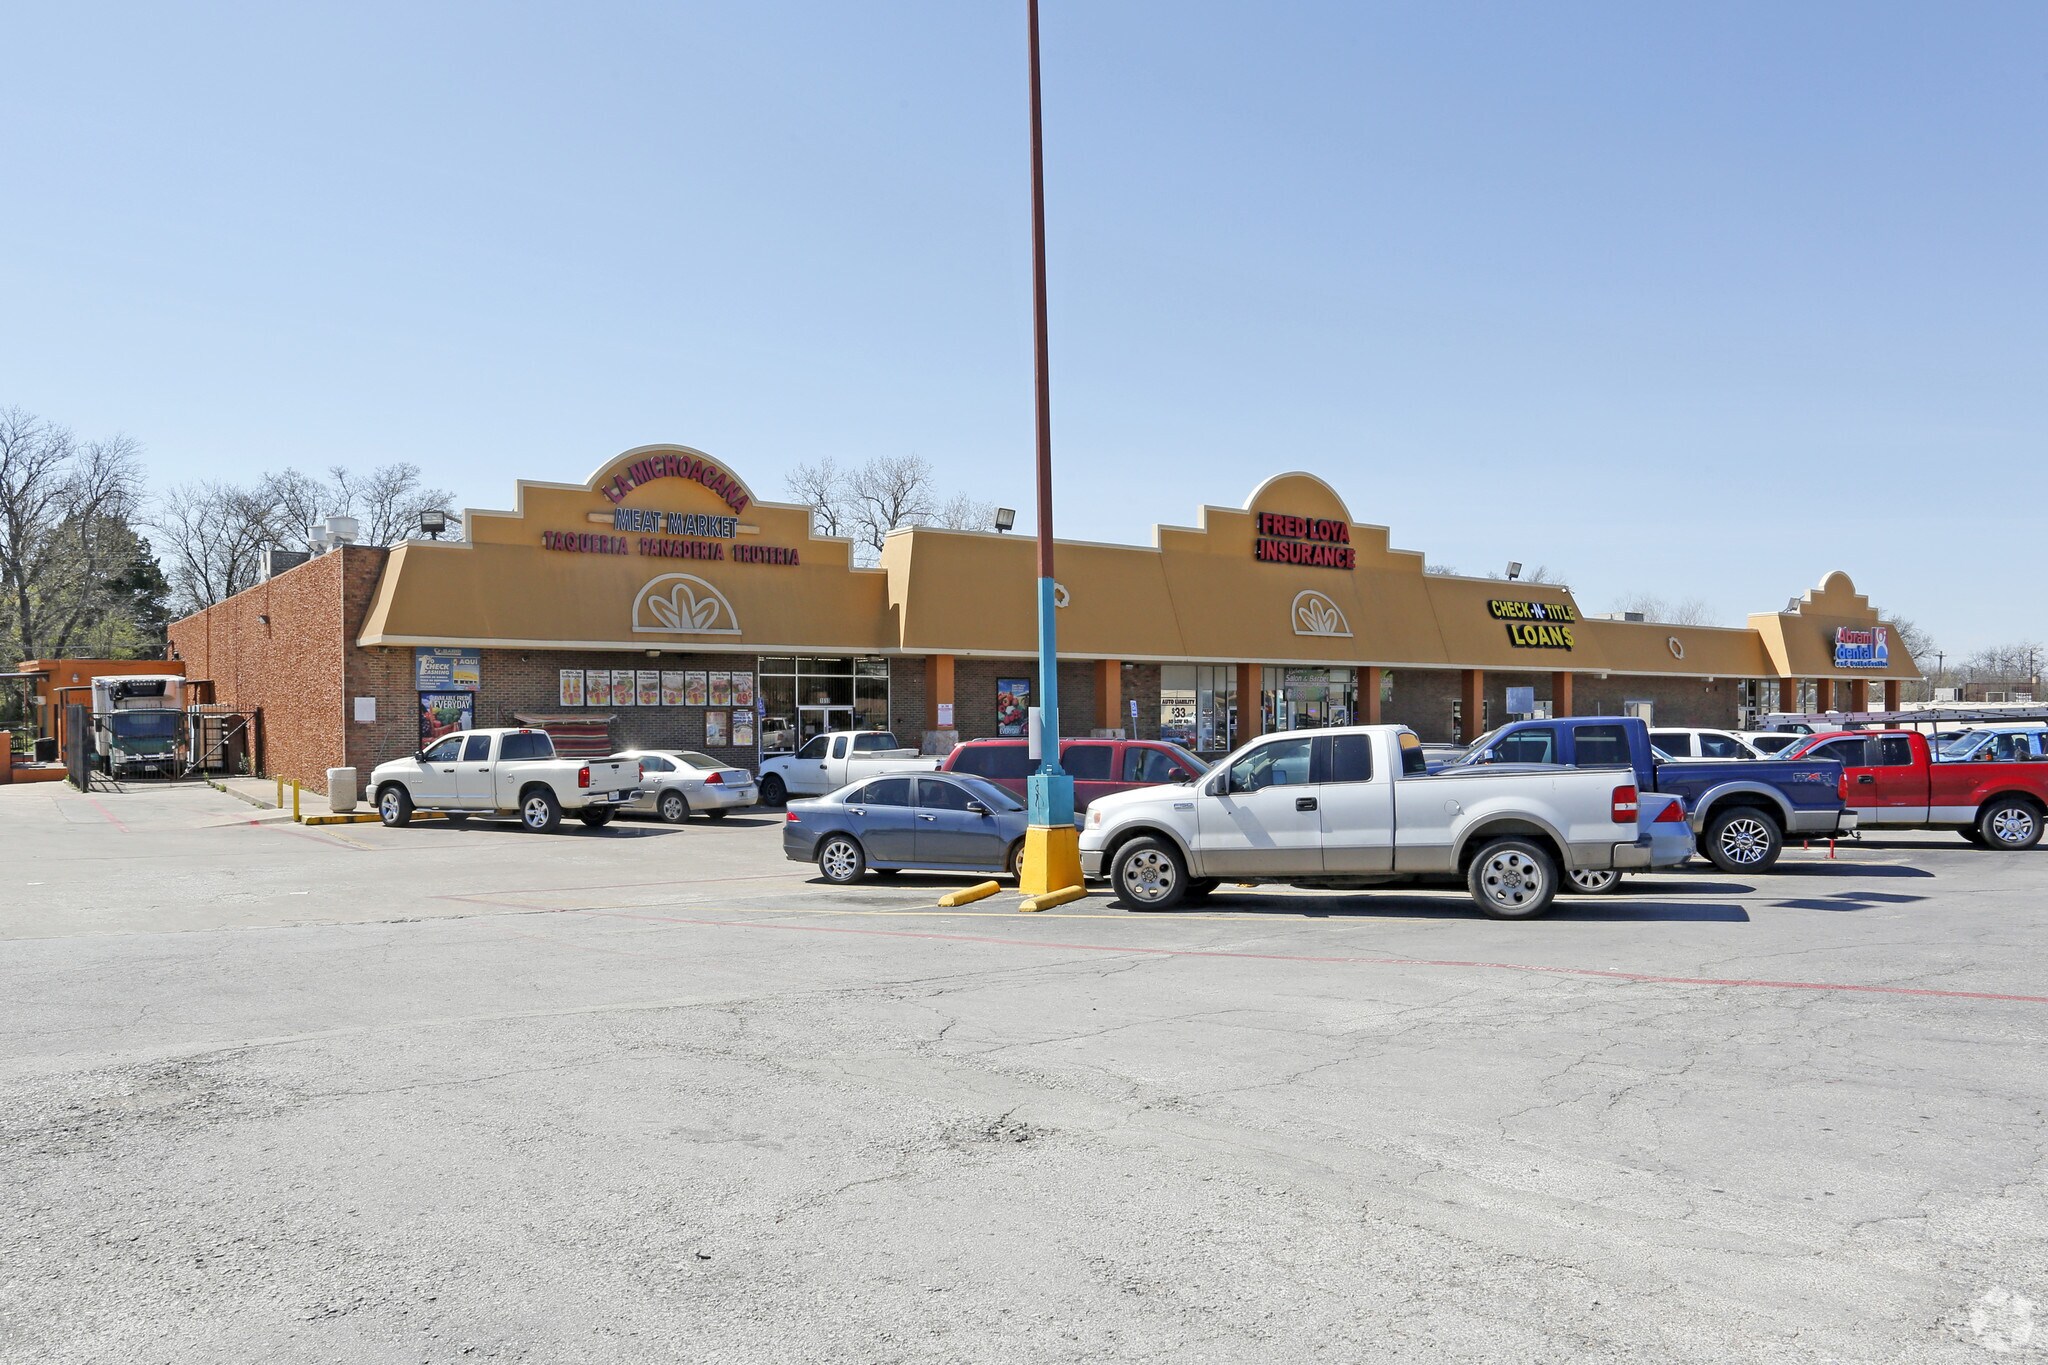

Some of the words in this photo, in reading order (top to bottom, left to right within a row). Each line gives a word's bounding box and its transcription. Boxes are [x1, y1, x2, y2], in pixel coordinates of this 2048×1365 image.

[601, 473, 634, 504] LA
[628, 455, 750, 515] MICHOACANA
[615, 507, 662, 533] MEAT
[667, 511, 739, 539] MARKET
[1259, 512, 1307, 539] FRED
[1306, 517, 1350, 544] LOYA
[544, 530, 629, 555] TAQUERIA
[640, 537, 725, 561] PANADERIA
[734, 544, 800, 566] FRUTERIA
[1257, 538, 1356, 570] INSURANCE
[1837, 627, 1872, 644] Abram
[1837, 644, 1872, 659] dental
[434, 700, 470, 709] EVERYDAY
[1171, 707, 1186, 718] $33
